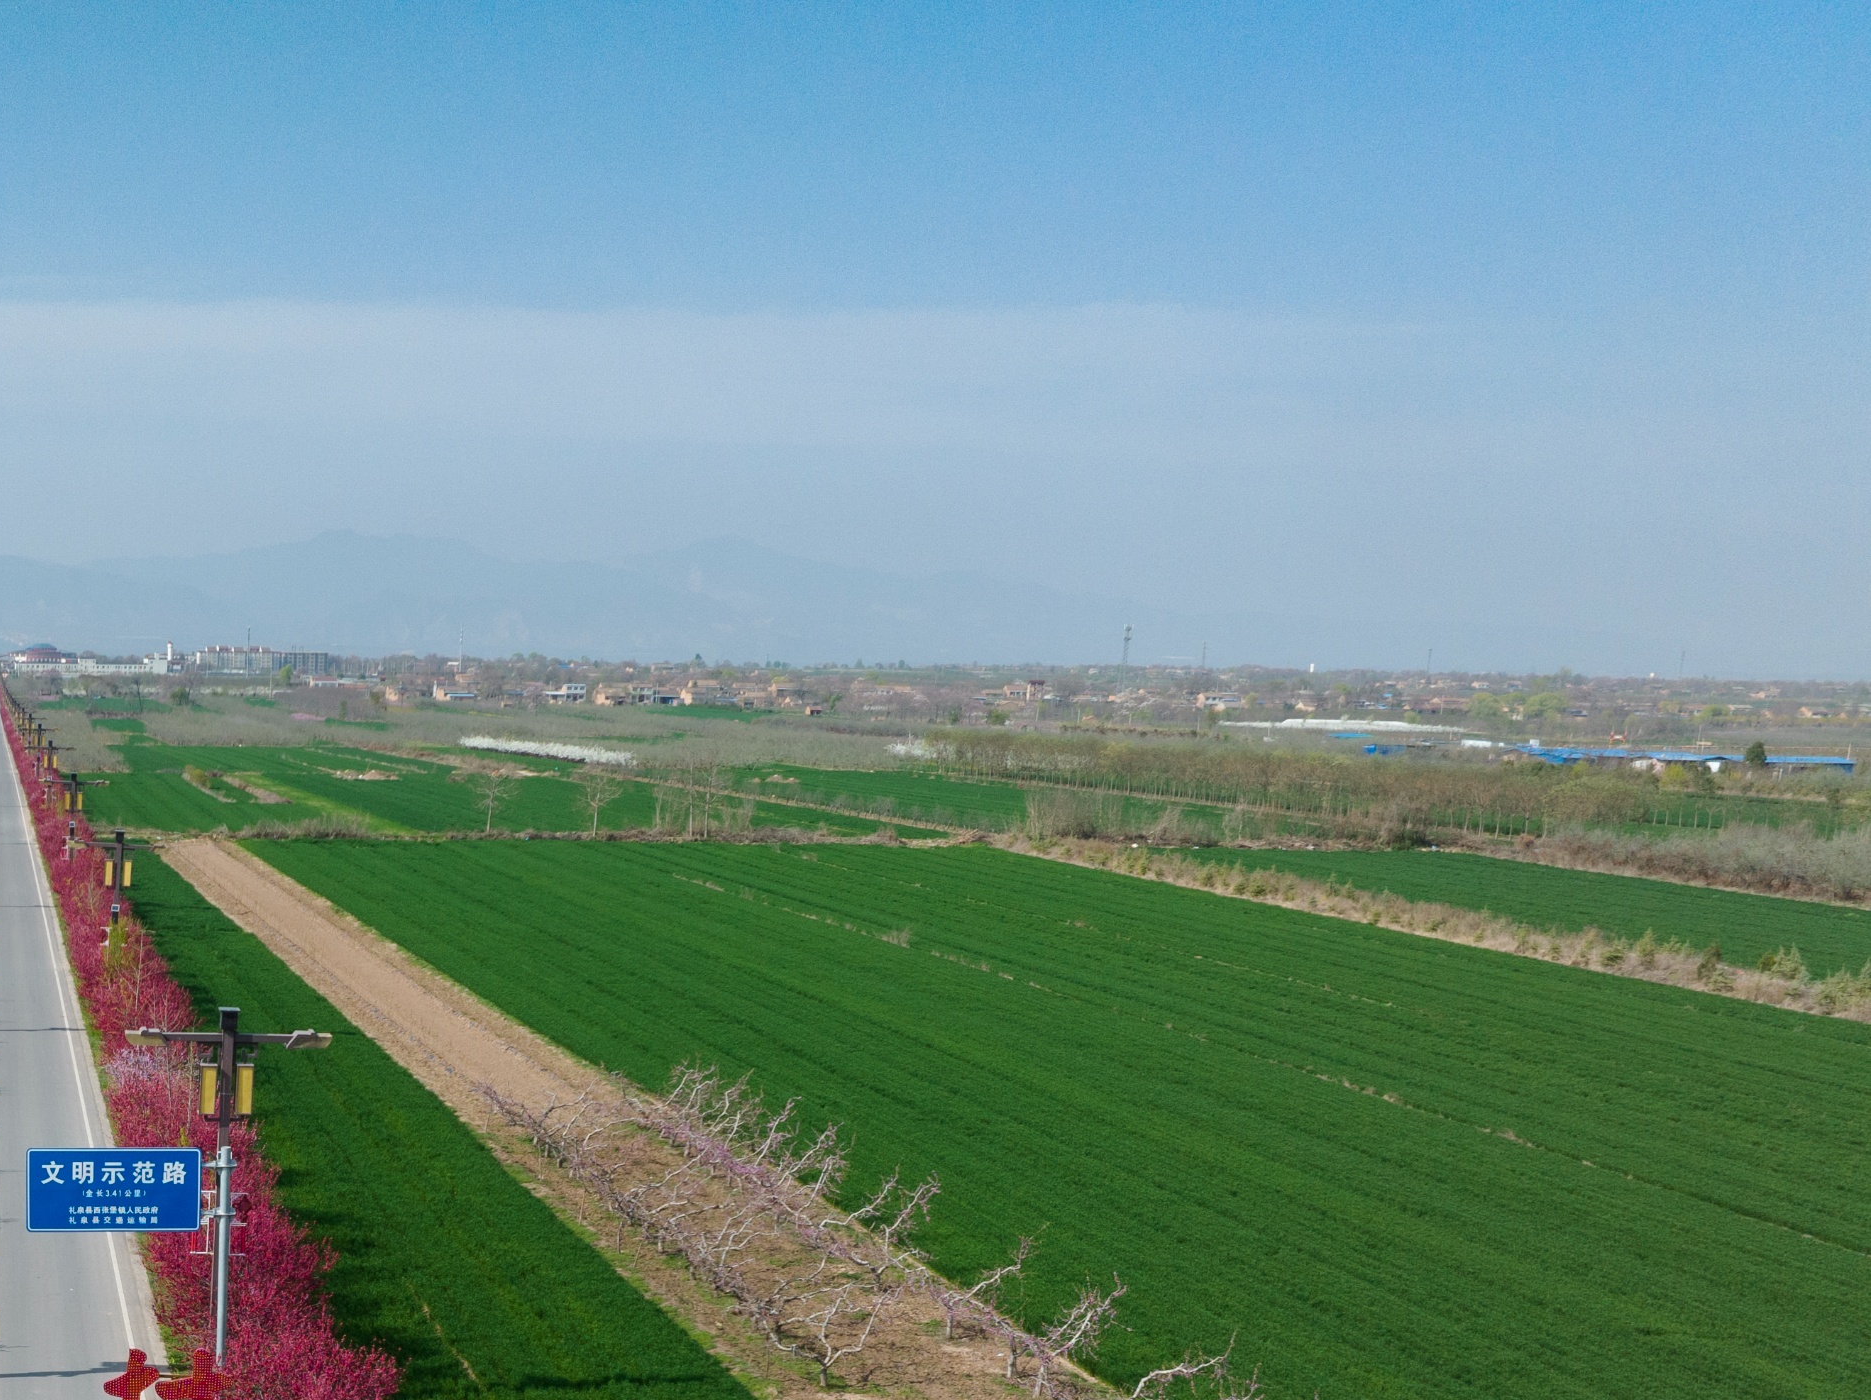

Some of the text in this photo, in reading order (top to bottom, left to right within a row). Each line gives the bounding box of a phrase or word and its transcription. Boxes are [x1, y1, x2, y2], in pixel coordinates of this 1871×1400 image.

[41, 1161, 187, 1185] 文明示范路
[69, 1206, 159, 1215] 礼泉县西张堡镇人民政府
[69, 1216, 159, 1225] 礼泉县交通运输局
